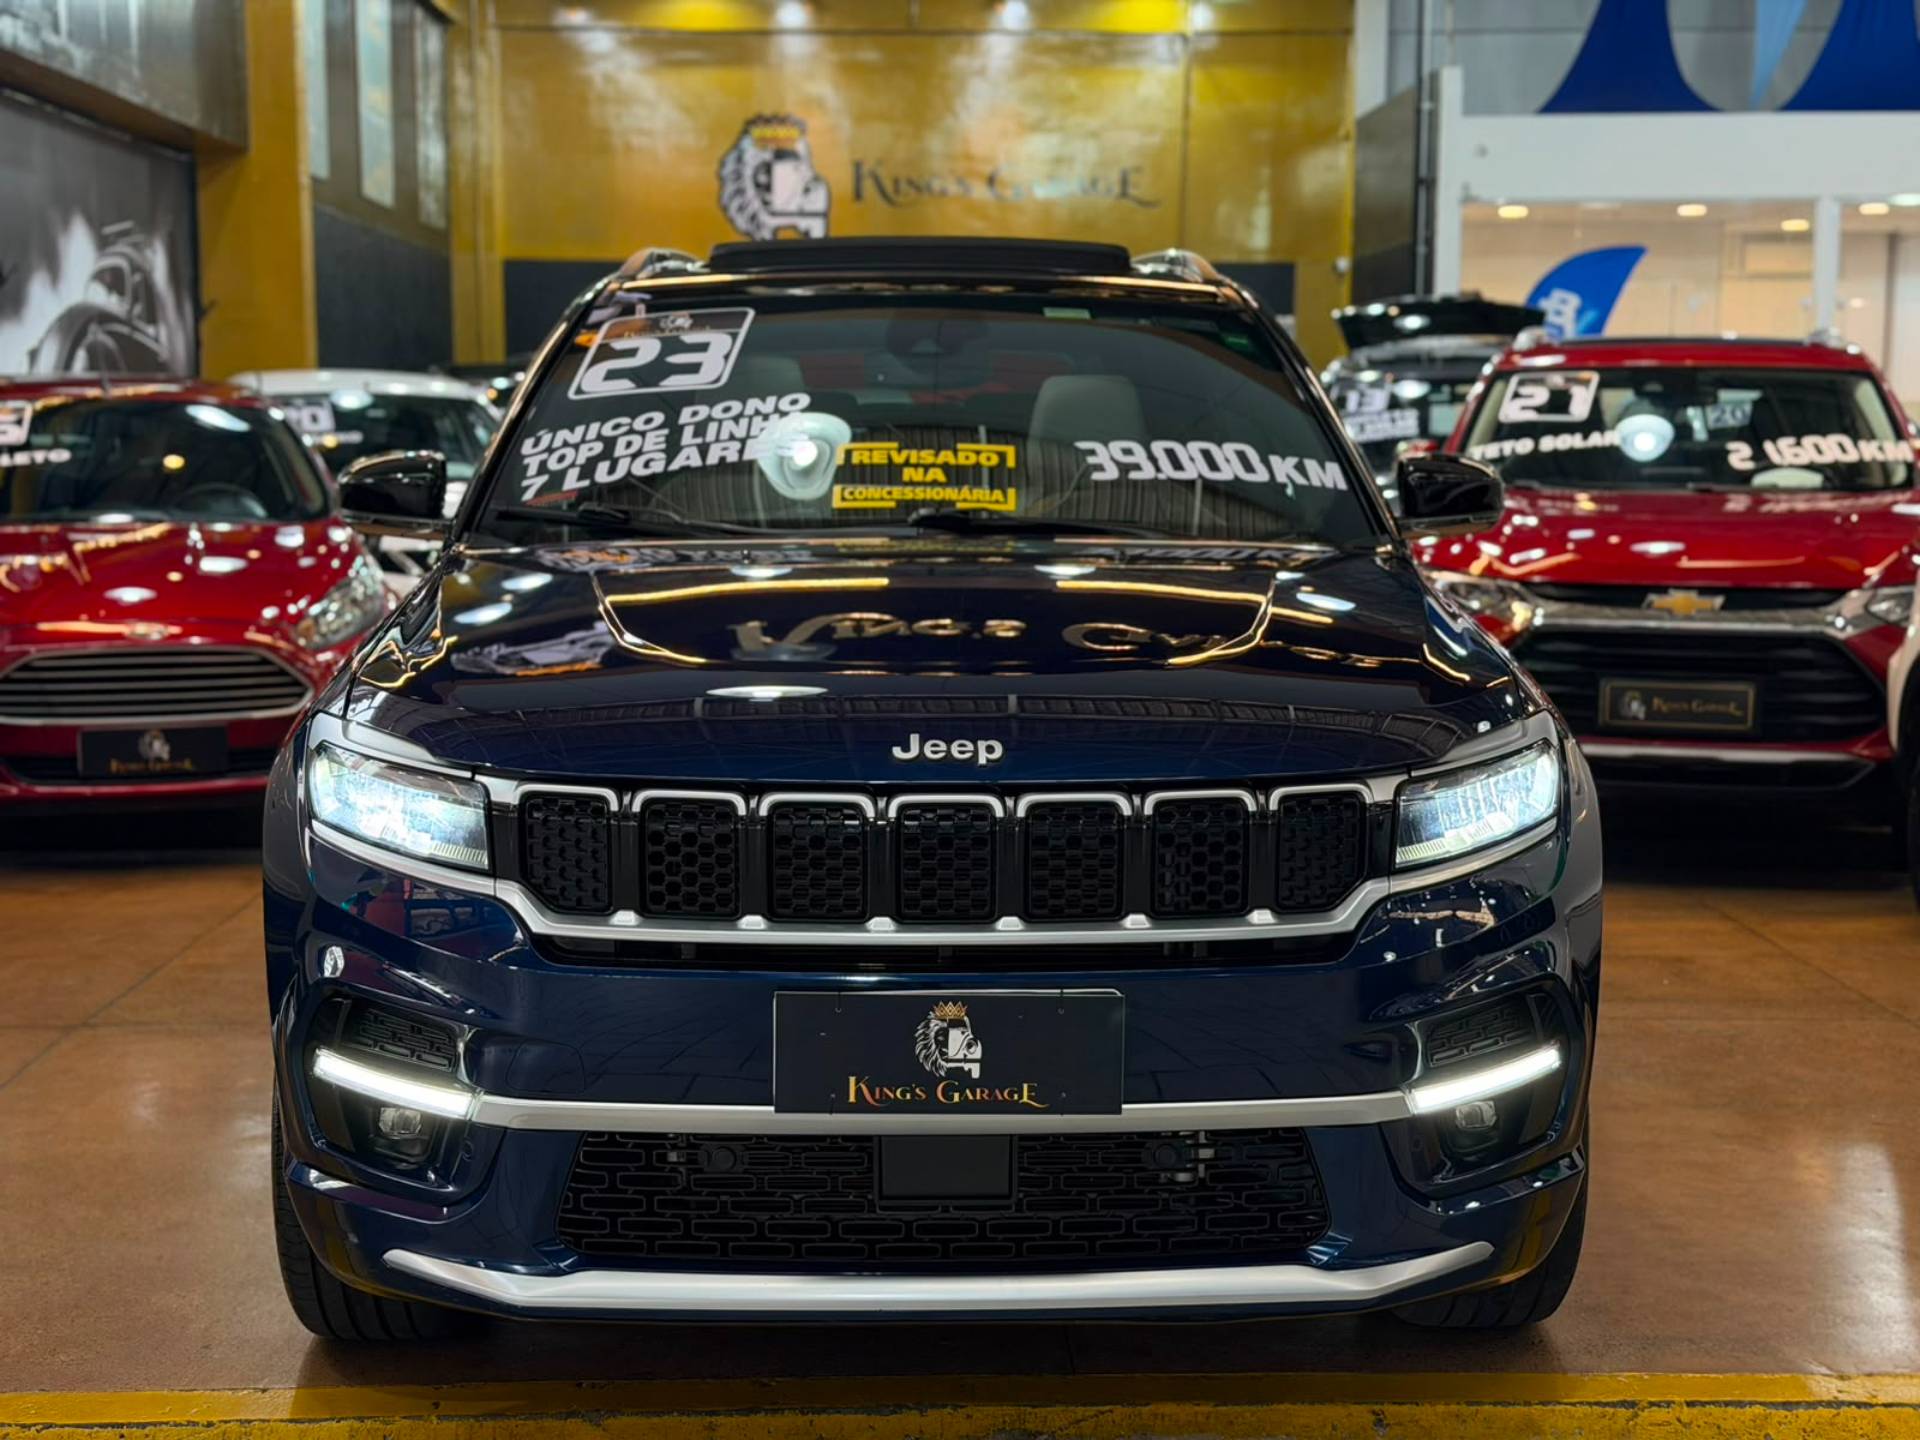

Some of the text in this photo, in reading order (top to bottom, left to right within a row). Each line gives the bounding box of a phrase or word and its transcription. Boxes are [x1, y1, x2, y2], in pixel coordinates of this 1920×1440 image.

[580, 333, 732, 393] 23
[1504, 385, 1588, 420] 21
[521, 392, 811, 456] ÚNICO DONO
[522, 440, 604, 477] TOP
[614, 428, 669, 458] DE
[851, 449, 1000, 466] REVISADO
[1467, 437, 1535, 460] TETO
[521, 438, 798, 501] 7 LUGARE
[902, 467, 947, 482] NA
[843, 485, 1005, 503] CONCESSIONÁRIA
[892, 733, 1003, 765] Jeep
[936, 1080, 1049, 1108] GARAGE
